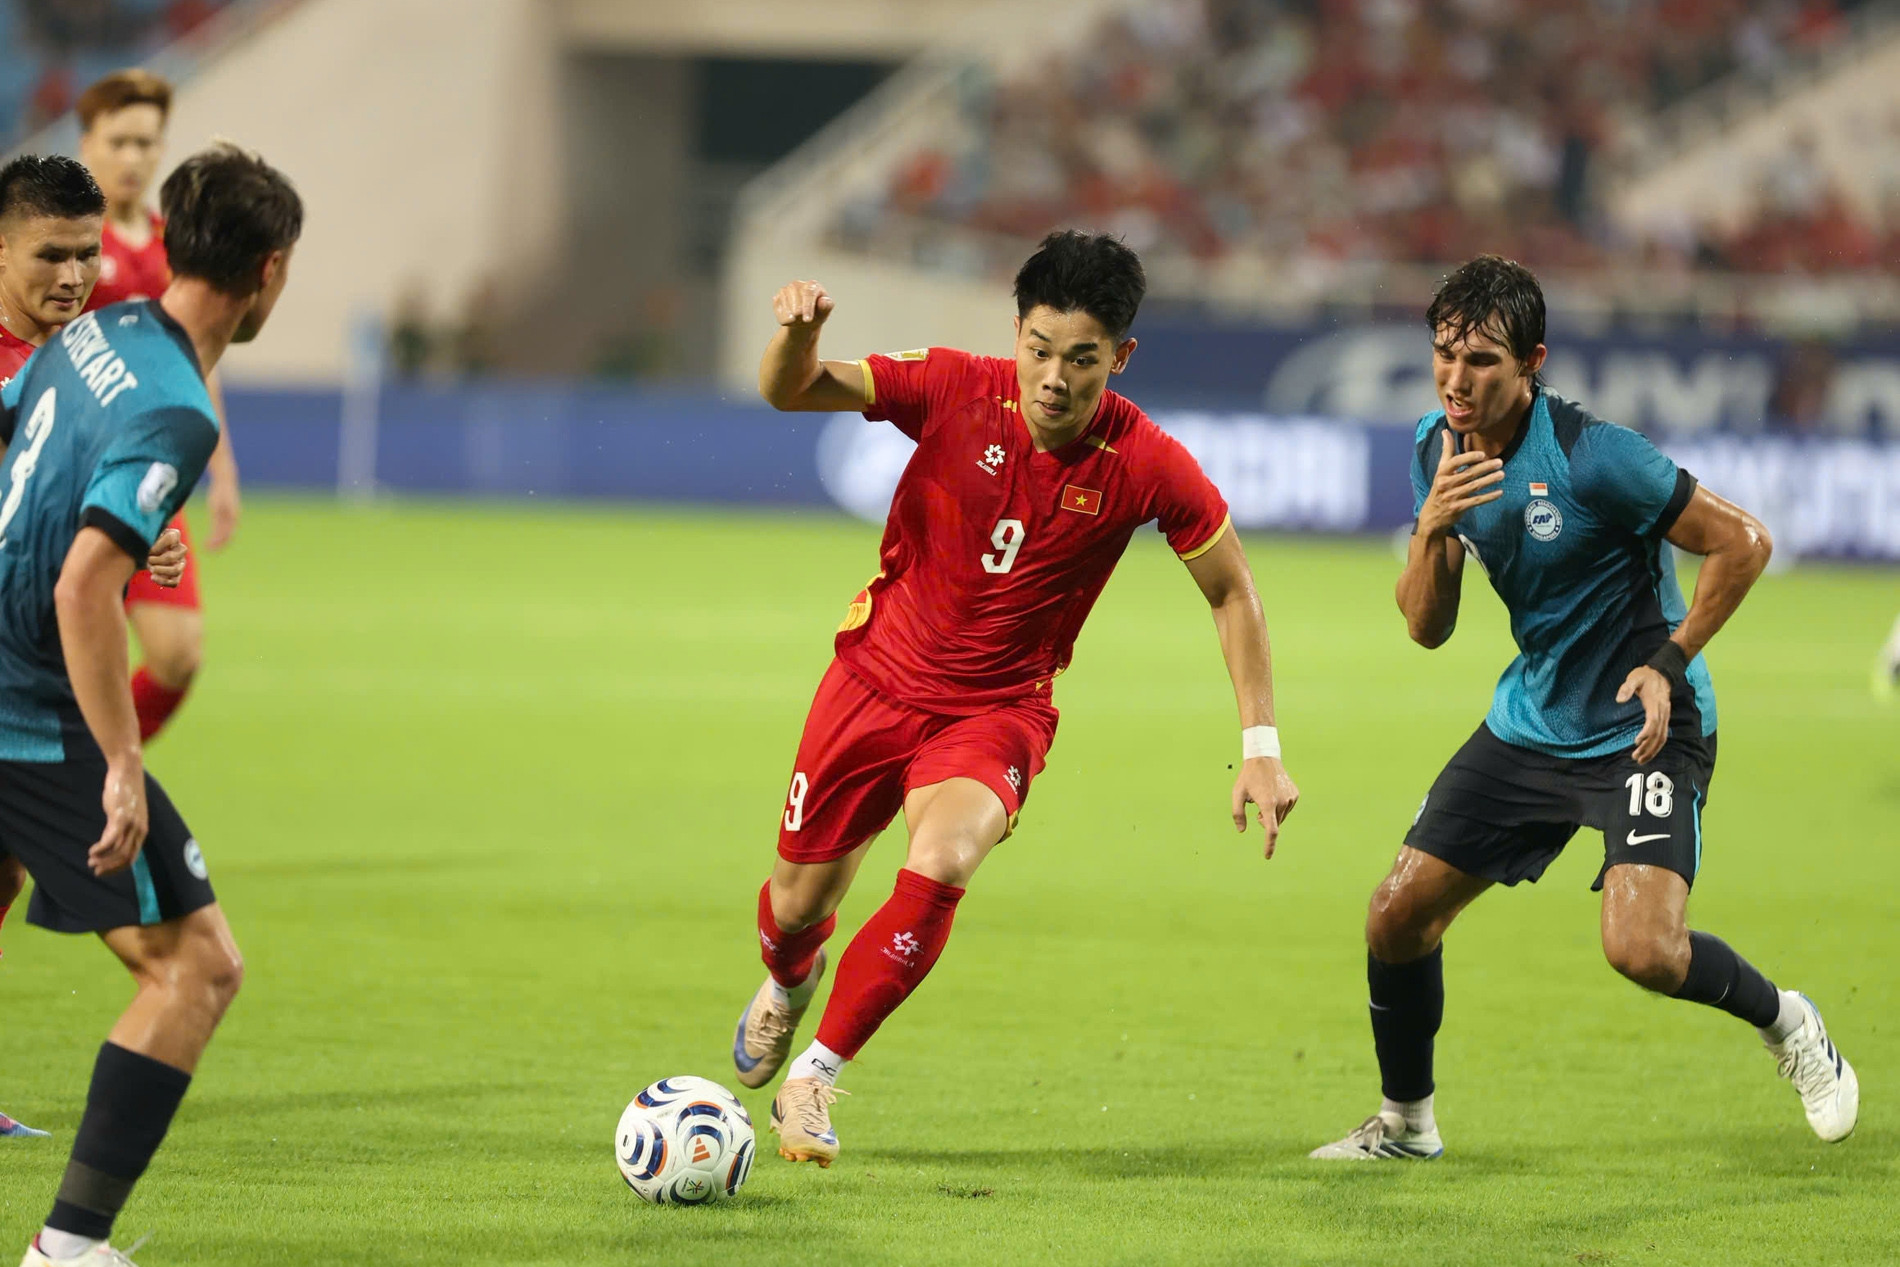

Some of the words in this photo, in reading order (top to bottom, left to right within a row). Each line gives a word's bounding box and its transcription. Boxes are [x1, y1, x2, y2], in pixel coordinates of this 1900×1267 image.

[981, 519, 1025, 573] 9
[784, 772, 808, 831] 9
[1625, 771, 1674, 818] 18
